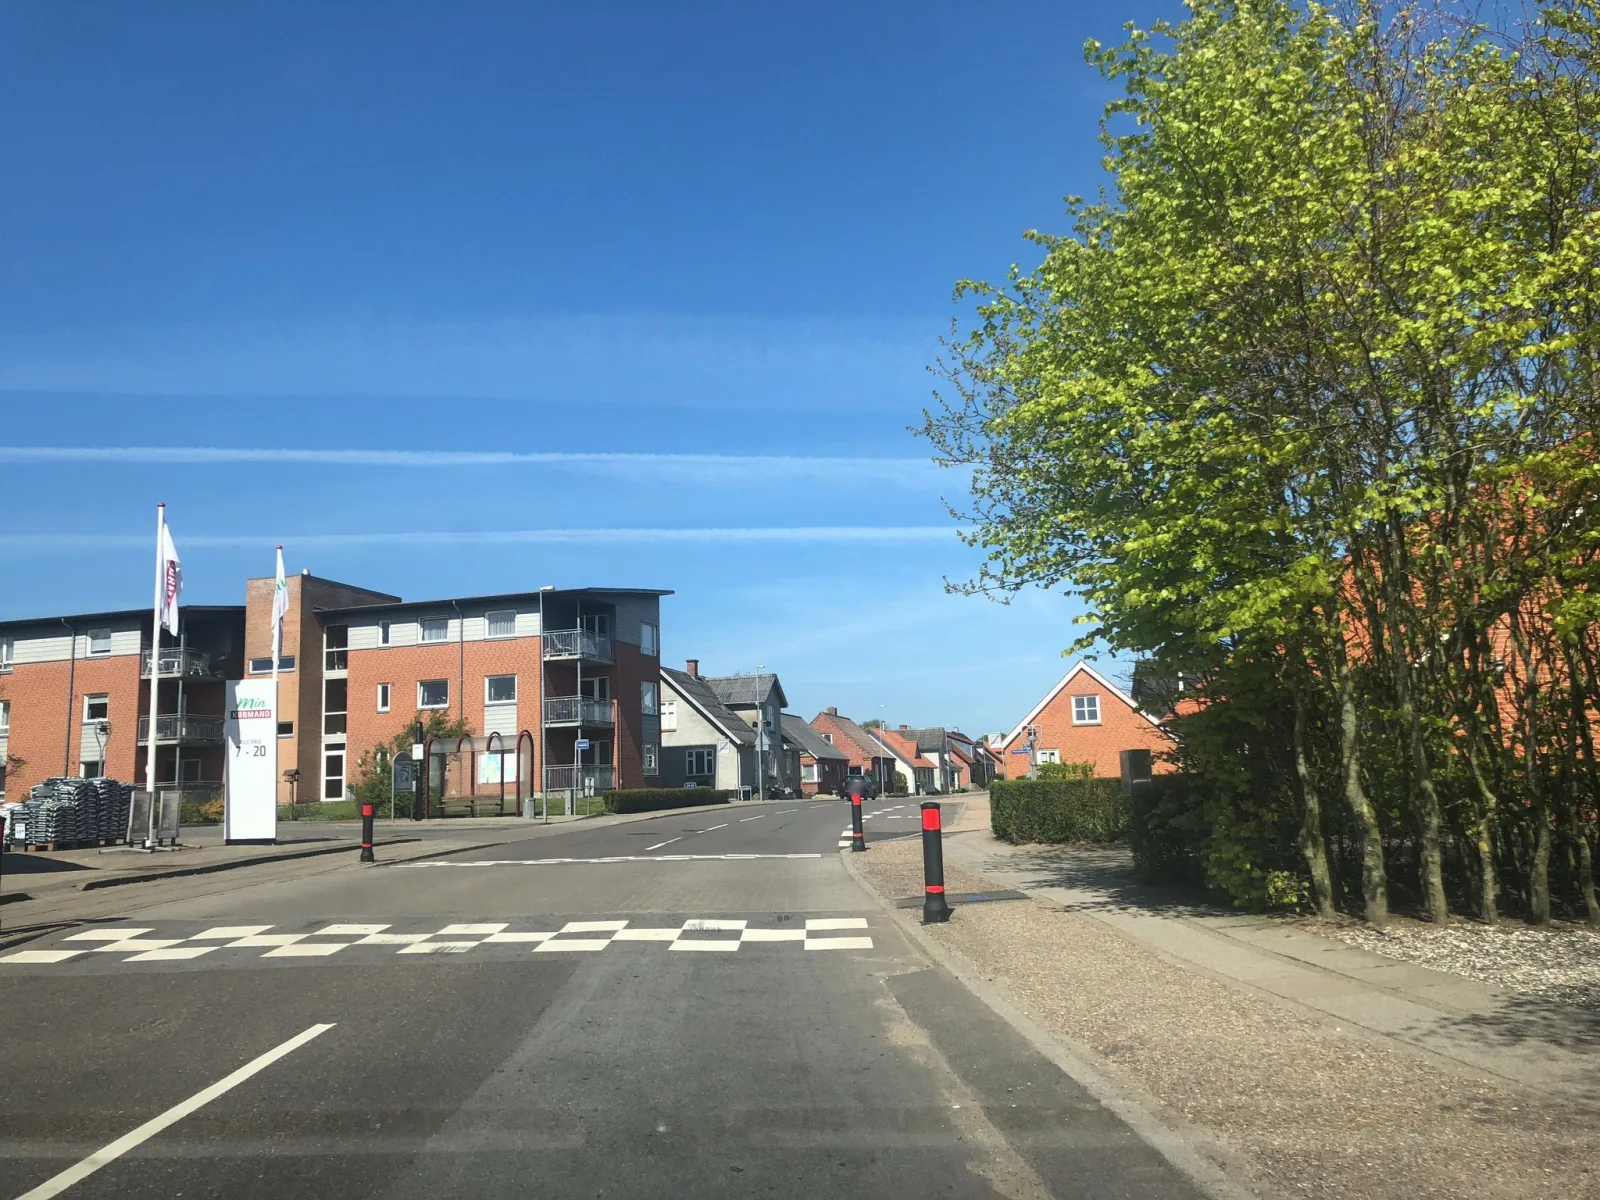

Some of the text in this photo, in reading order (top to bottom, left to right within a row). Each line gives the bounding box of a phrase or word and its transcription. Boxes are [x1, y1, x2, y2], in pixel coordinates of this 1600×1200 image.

[235, 697, 266, 709] Min
[232, 710, 270, 718] KØBMAND
[235, 745, 241, 757] 7
[253, 745, 266, 757] 20
